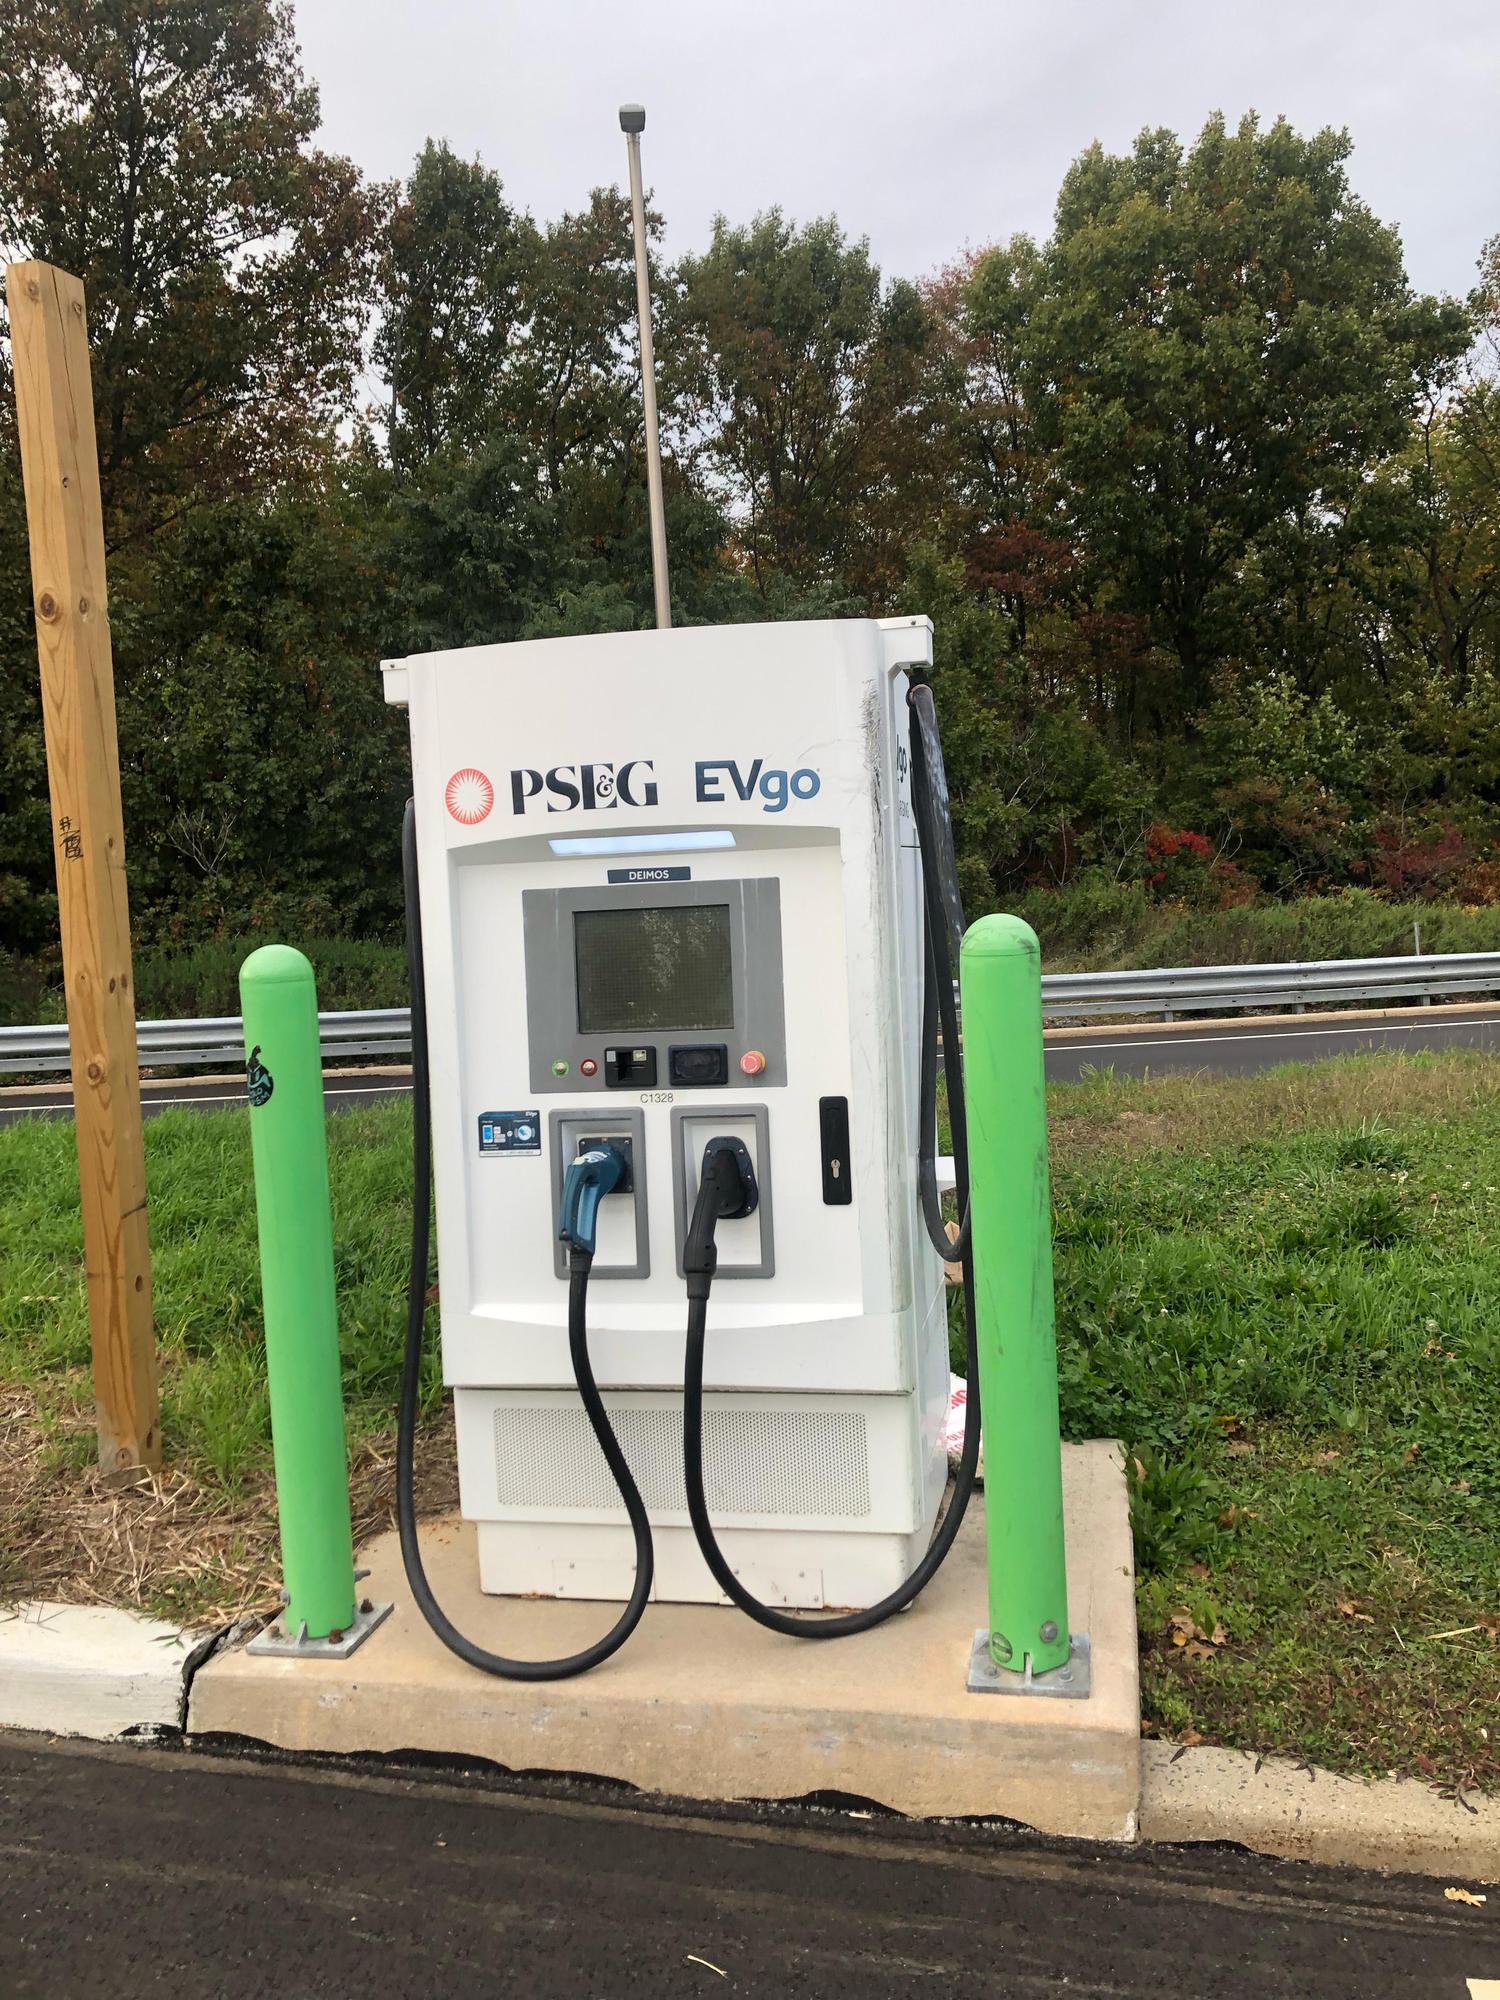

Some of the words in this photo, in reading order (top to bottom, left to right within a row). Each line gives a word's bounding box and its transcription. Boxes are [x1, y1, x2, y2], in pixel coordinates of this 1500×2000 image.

[694, 758, 821, 813] EVgo
[628, 870, 670, 880] DEIMOS
[640, 1093, 674, 1104] C1328
